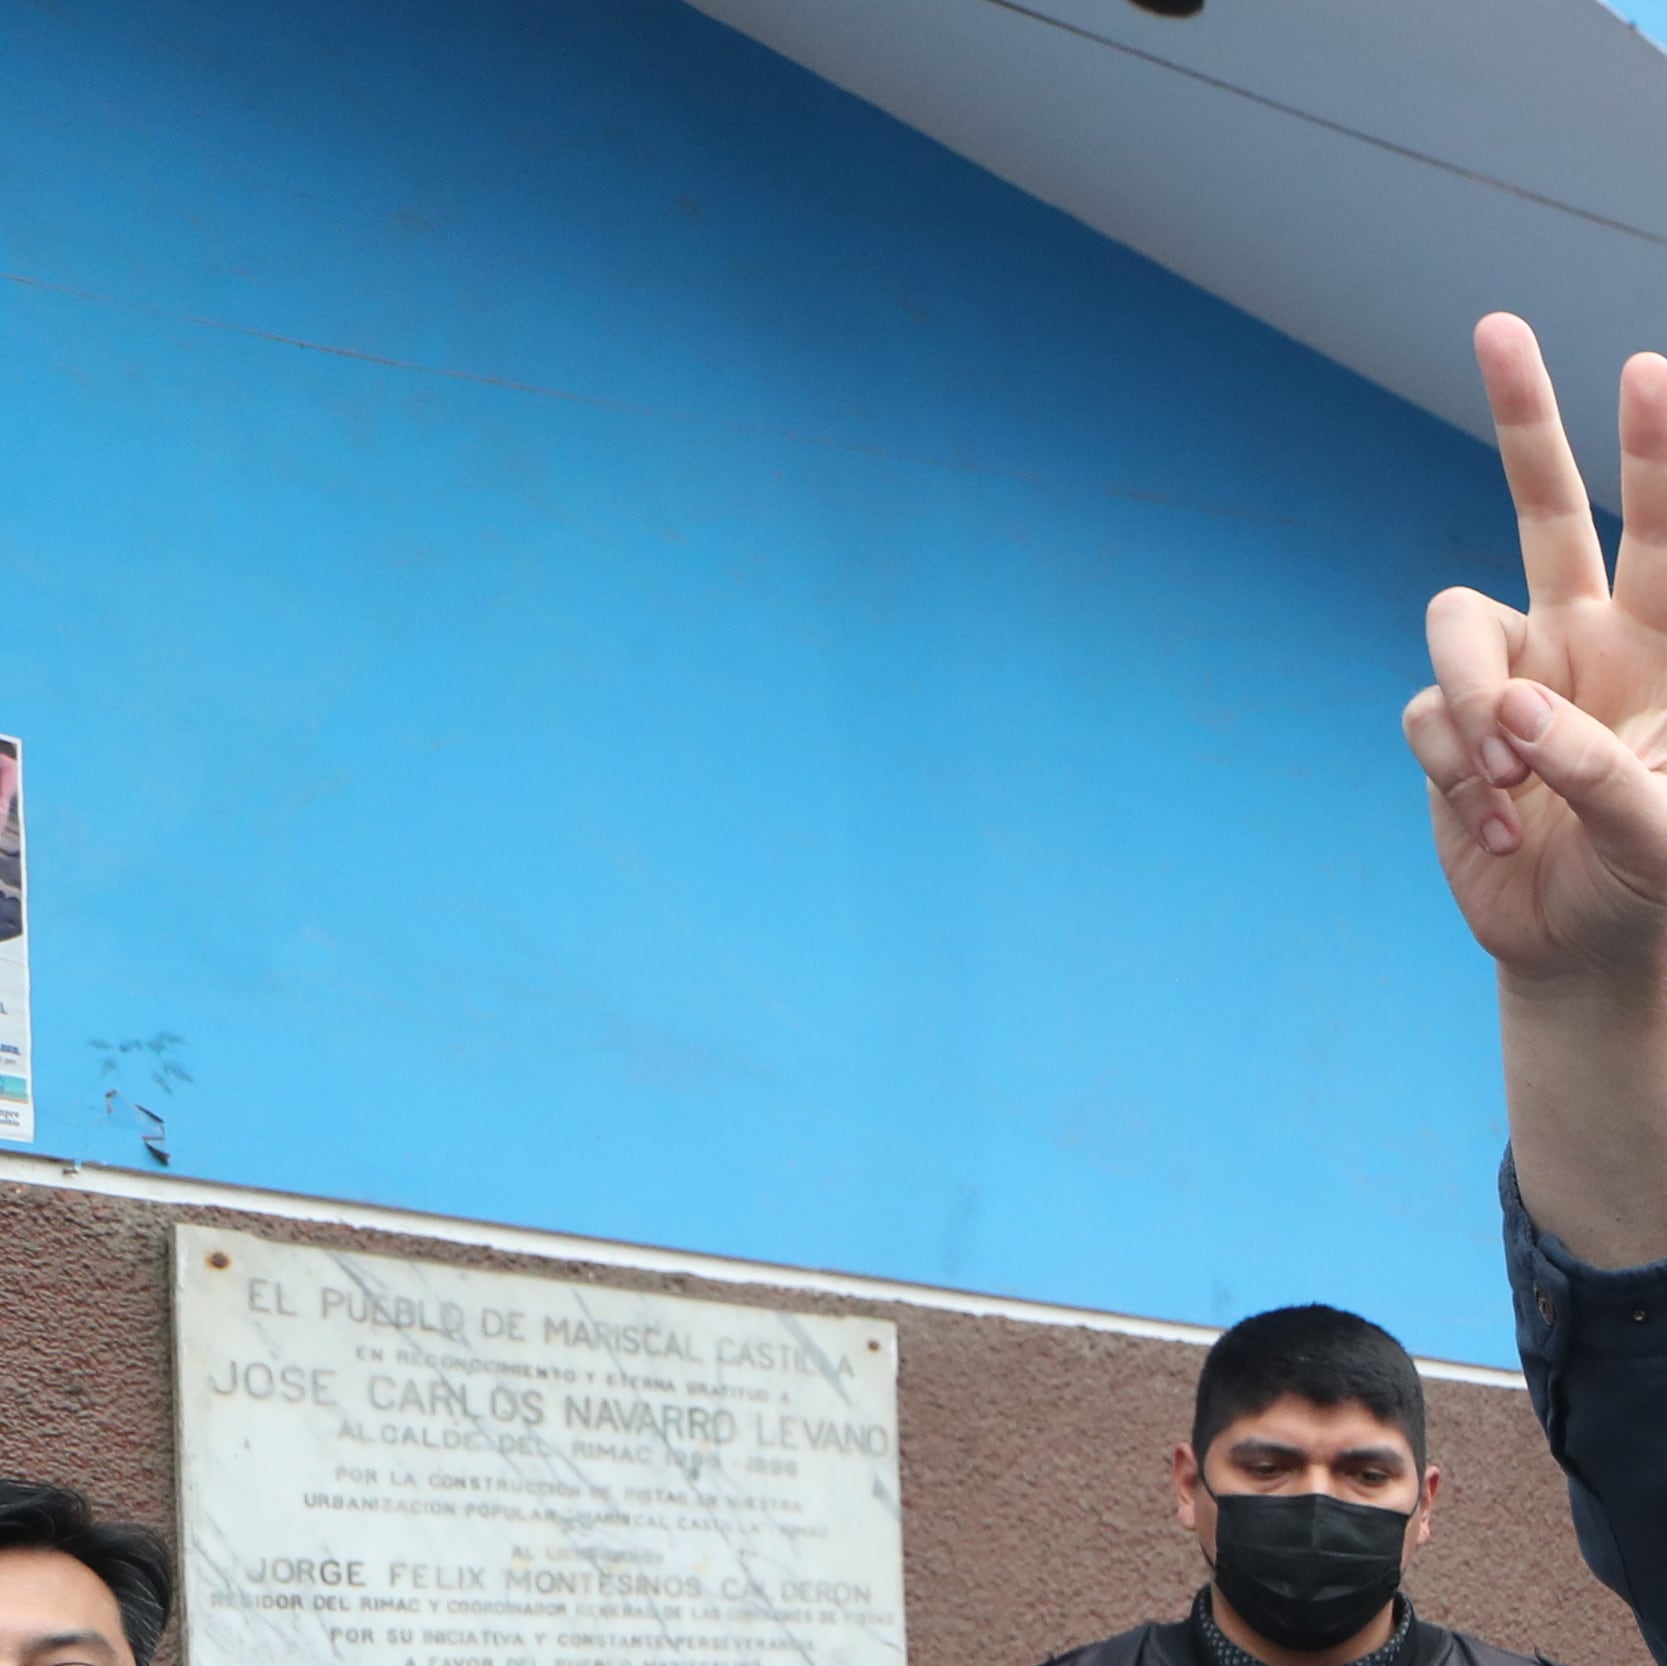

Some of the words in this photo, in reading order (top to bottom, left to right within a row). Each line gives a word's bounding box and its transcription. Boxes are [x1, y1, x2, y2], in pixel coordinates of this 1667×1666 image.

[247, 1277, 298, 1317] EL
[320, 1285, 466, 1336] PUEBLO
[481, 1306, 526, 1344] DE
[543, 1315, 703, 1363] MARISCAL
[206, 1359, 337, 1406] JOSE
[367, 1374, 545, 1427] CARLOS
[564, 1394, 737, 1446] NAVARRO
[755, 1411, 890, 1459] LEVANO
[336, 1418, 483, 1450] ALCALDE
[570, 1440, 652, 1465] RIMAC
[335, 1465, 378, 1486] POR
[389, 1470, 418, 1488] LA
[303, 1492, 458, 1518] URBANIZACION
[245, 1556, 367, 1589] JORGE
[388, 1562, 487, 1591] FELIX
[505, 1567, 702, 1601] MONTESINOS
[312, 1594, 352, 1612] DEL
[359, 1595, 421, 1615] RIMAC
[329, 1626, 376, 1645] POR
[386, 1626, 414, 1645] SU
[422, 1627, 525, 1647] INICIATIVA
